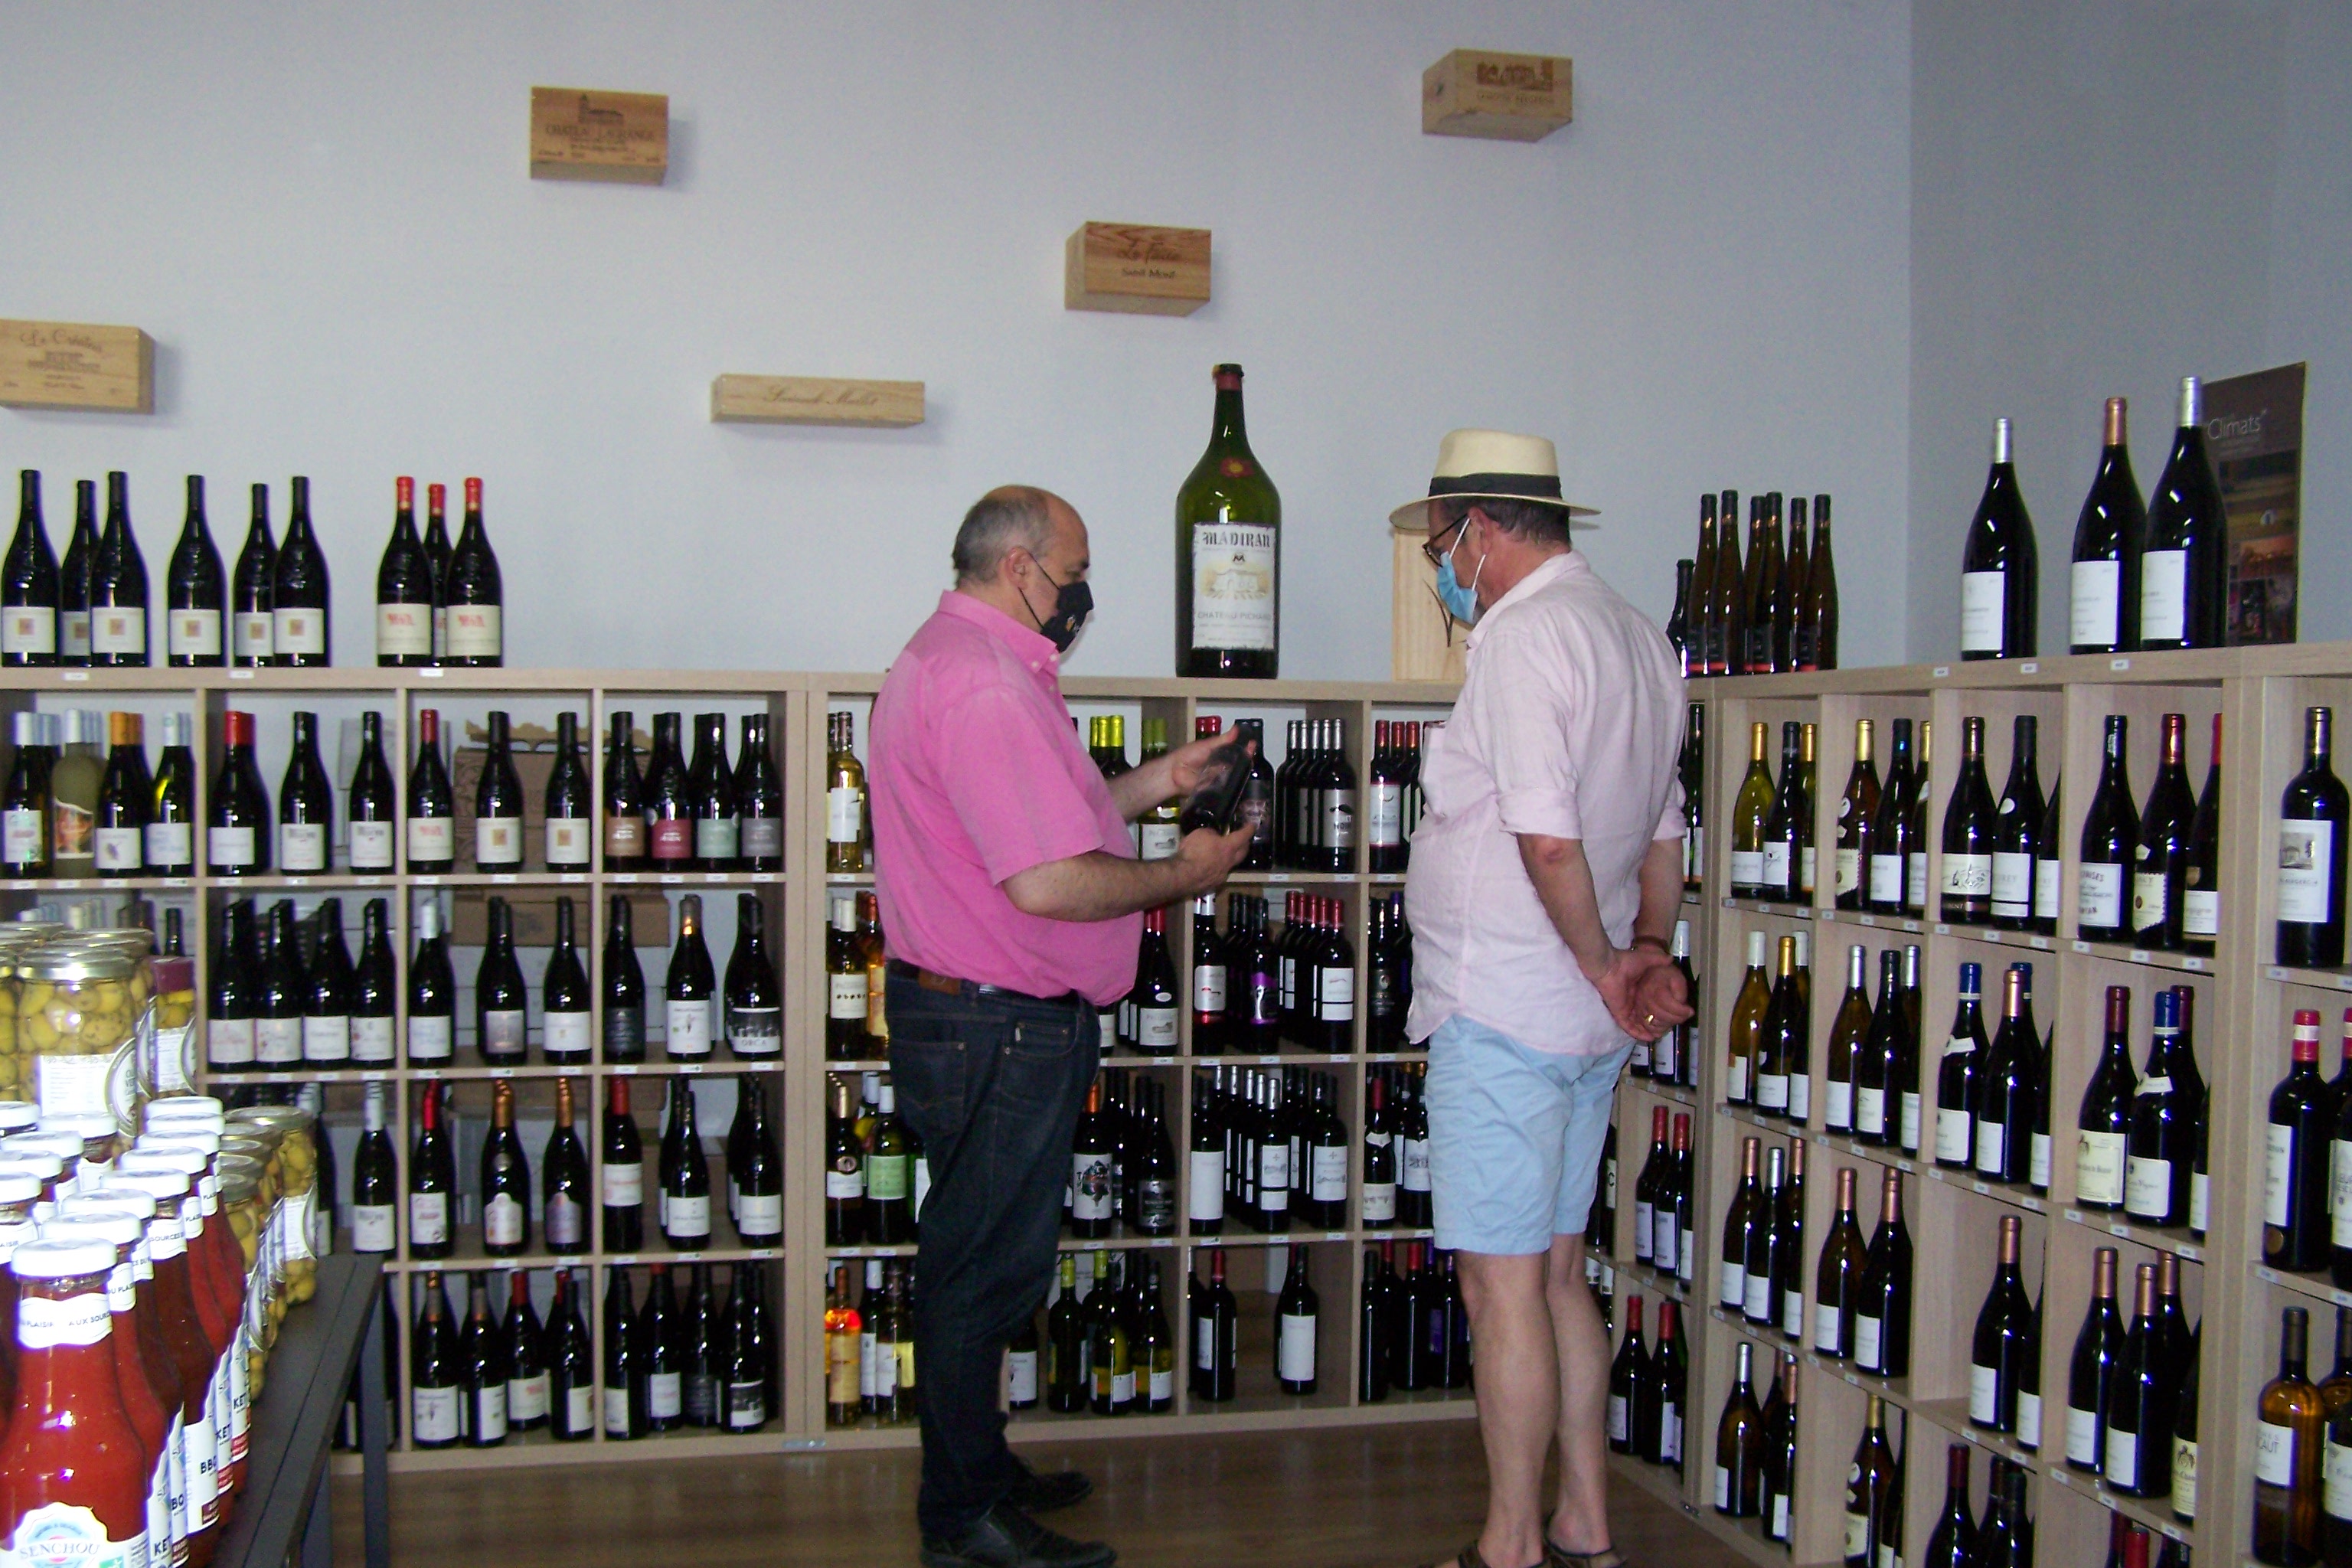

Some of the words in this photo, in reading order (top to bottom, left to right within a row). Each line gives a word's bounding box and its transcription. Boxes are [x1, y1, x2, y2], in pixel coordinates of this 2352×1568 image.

[2207, 416, 2261, 439] Climats
[1202, 532, 1271, 548] MADIRAN
[20, 1542, 100, 1560] SENCHOU
